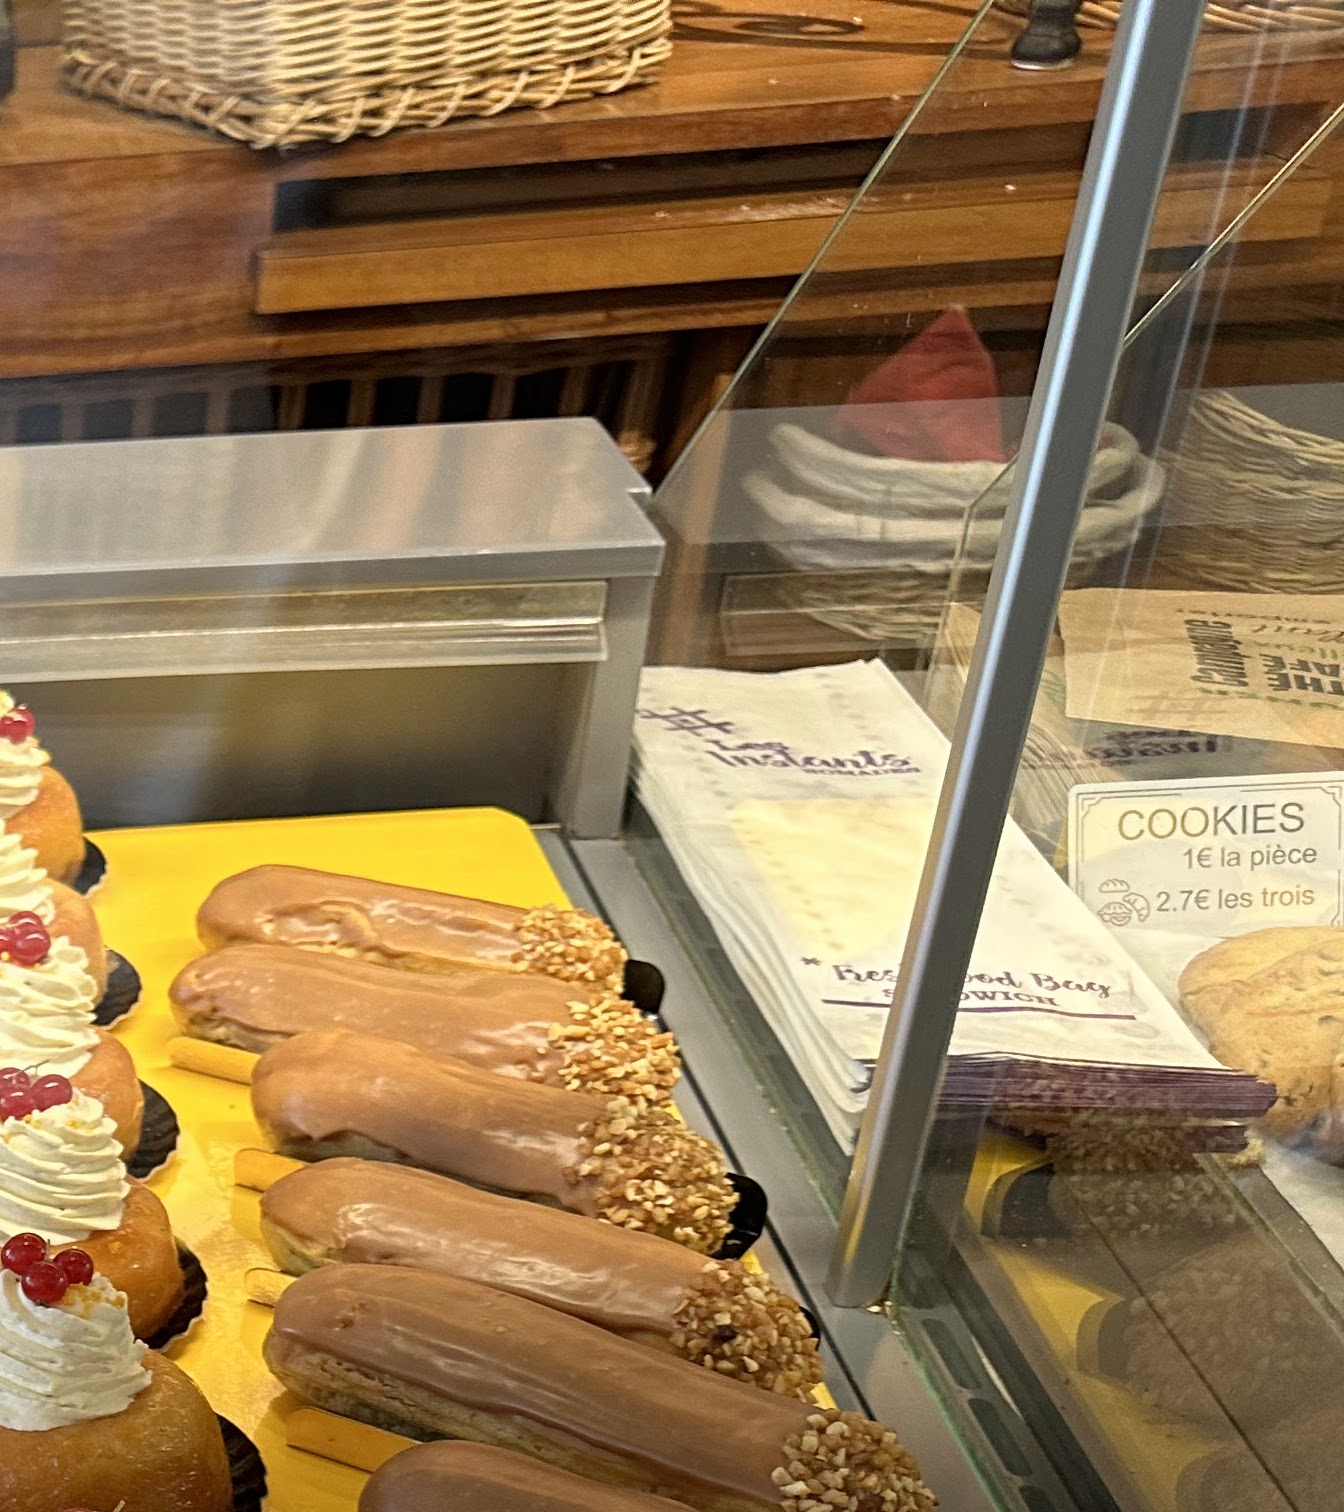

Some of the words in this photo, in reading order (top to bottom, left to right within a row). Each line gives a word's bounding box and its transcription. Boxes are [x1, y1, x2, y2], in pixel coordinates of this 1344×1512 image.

[705, 750, 911, 768] Instants
[1118, 802, 1305, 841] COOKIES
[1183, 847, 1213, 869] 1€
[1220, 847, 1241, 868] la
[1250, 845, 1318, 871] pièce
[1156, 889, 1210, 912] 2.7€
[1218, 889, 1253, 910] les
[1261, 885, 1315, 907] trois
[1030, 971, 1111, 999] Bag
